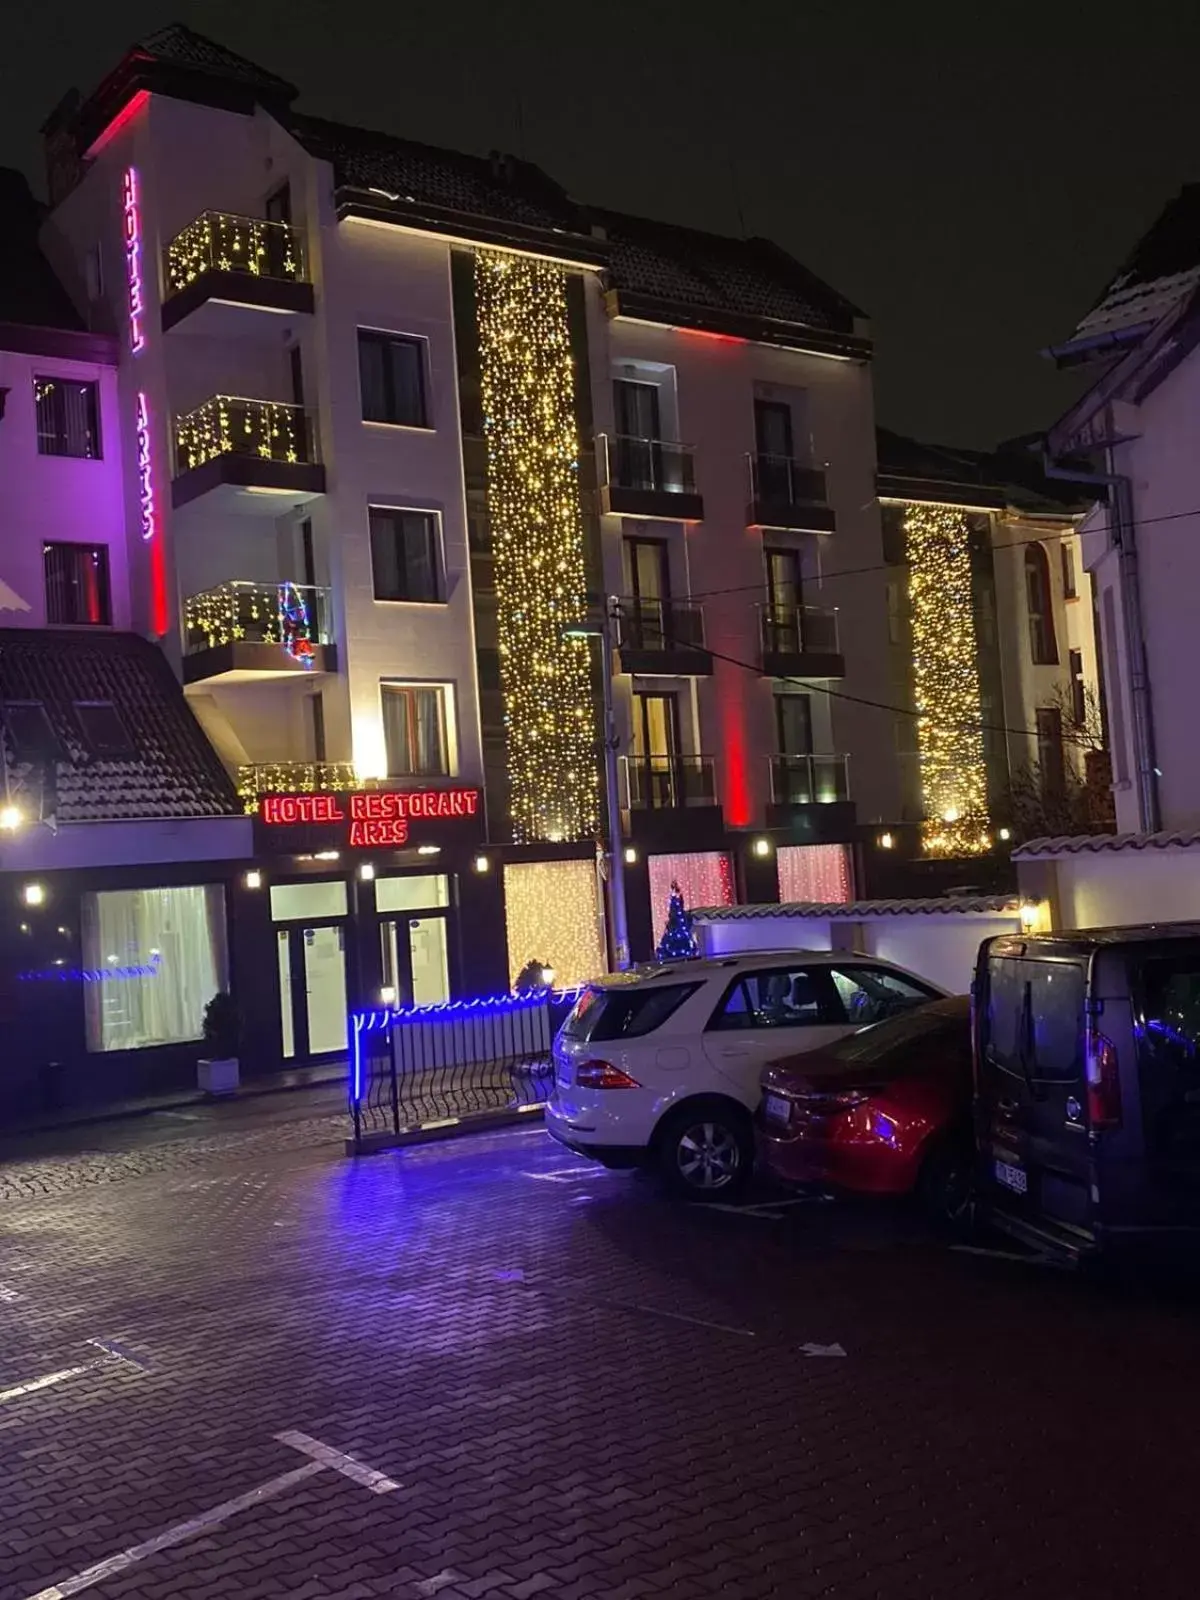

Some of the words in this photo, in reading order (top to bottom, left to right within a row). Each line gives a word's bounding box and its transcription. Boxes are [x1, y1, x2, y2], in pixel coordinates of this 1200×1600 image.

[264, 797, 344, 822] HOTEL
[351, 790, 478, 819] RESTORANT
[350, 820, 409, 845] ARIS
